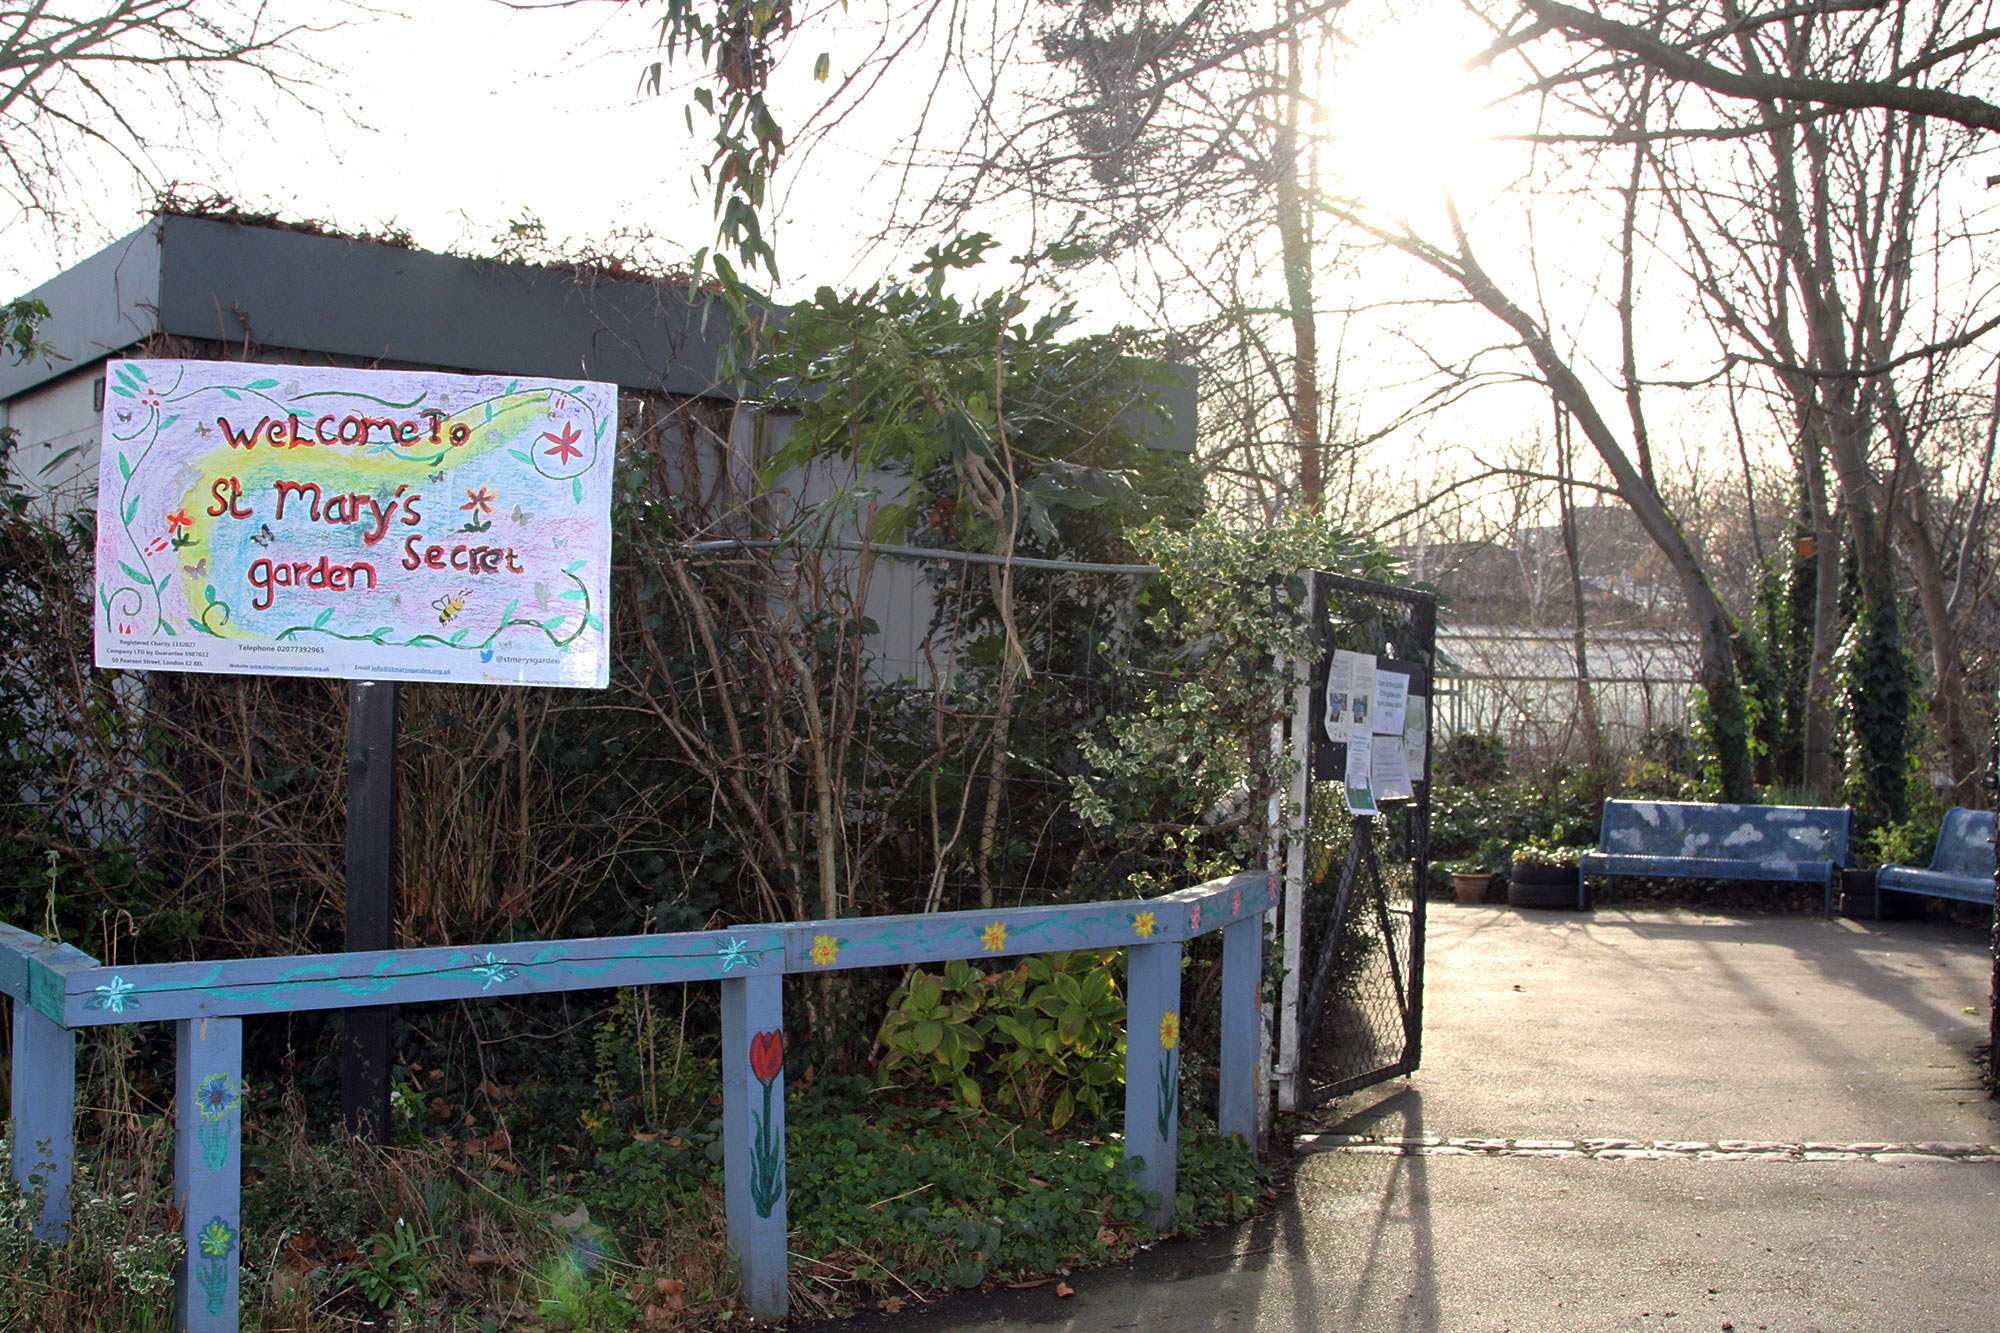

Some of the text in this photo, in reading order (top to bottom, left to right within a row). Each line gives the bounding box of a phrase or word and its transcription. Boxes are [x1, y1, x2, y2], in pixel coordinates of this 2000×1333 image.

[206, 477, 253, 520] St
[401, 534, 525, 575] Secret
[247, 556, 378, 611] garden
[120, 639, 149, 647] Registered
[150, 640, 171, 648] Charity
[238, 644, 325, 654] Telephone 02077392965
[106, 648, 133, 656] Company
[146, 649, 153, 657] by
[495, 655, 561, 666] @stmarysgarden
